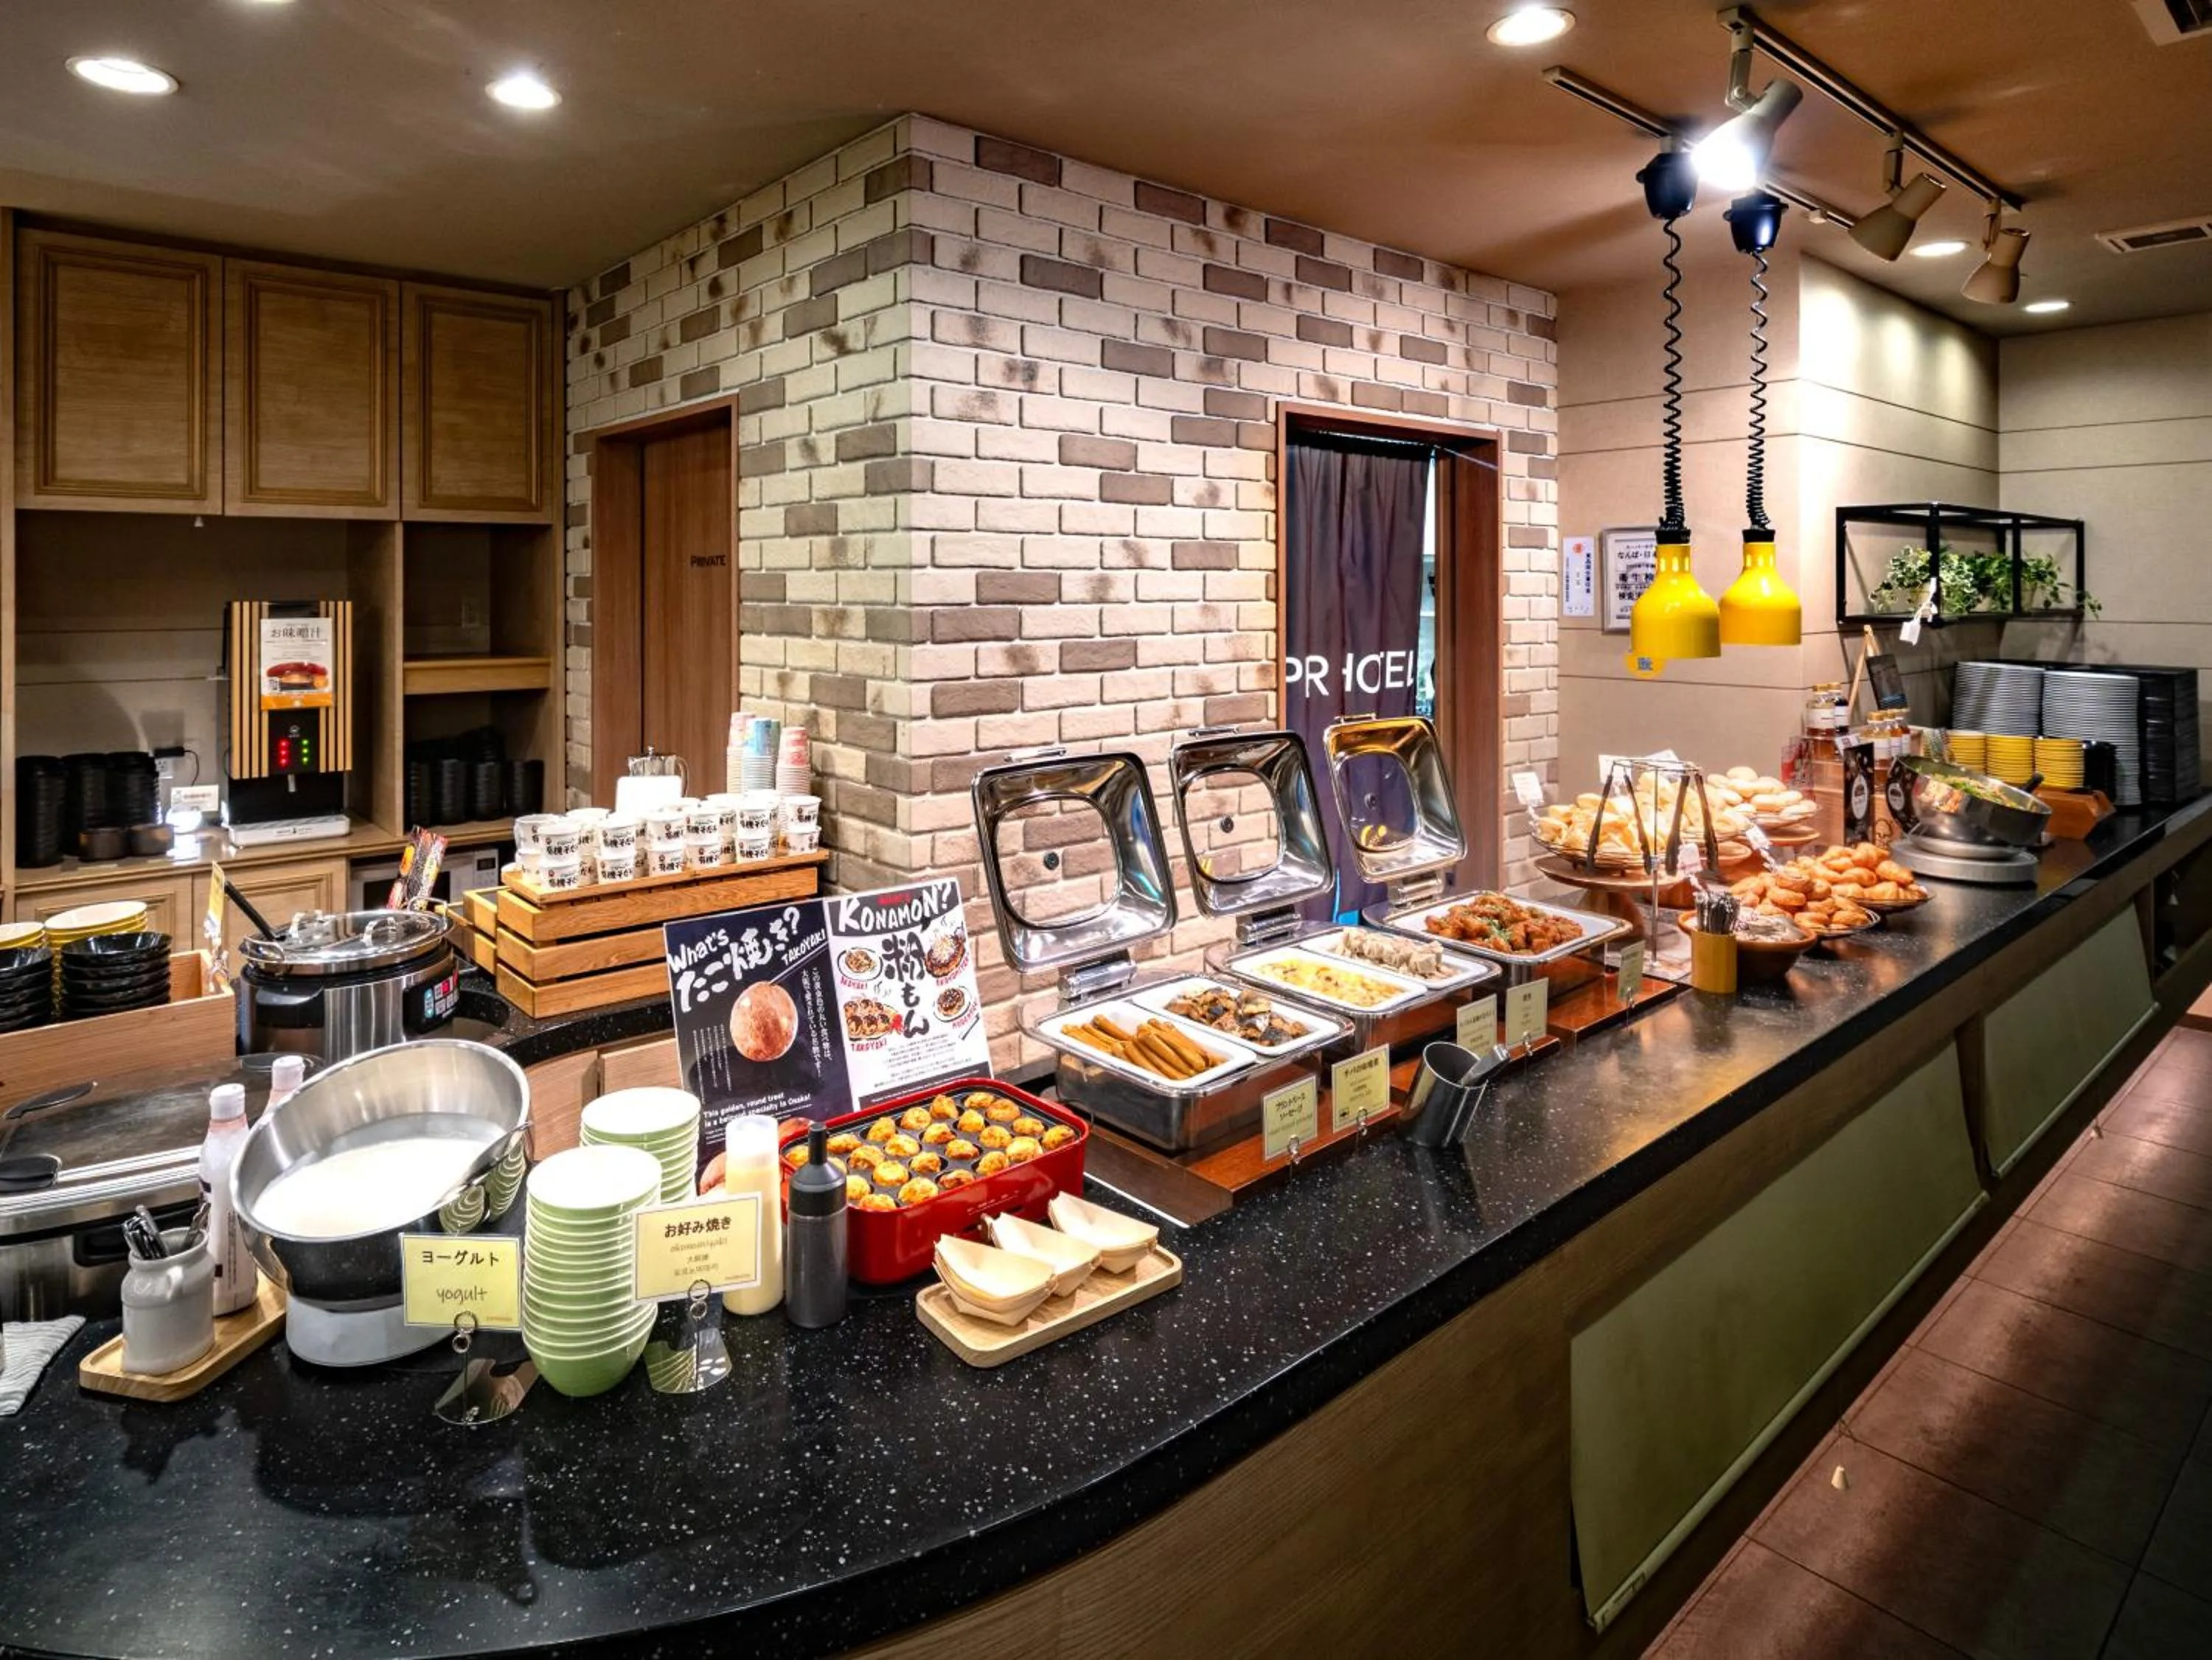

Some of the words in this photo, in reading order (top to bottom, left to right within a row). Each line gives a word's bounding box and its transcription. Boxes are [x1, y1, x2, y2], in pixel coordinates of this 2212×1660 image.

[1342, 650, 1414, 694] HOEL
[838, 882, 951, 932] KONAMON?
[666, 928, 729, 973] What's
[781, 929, 826, 966] TAKOYAKI
[881, 931, 930, 1039] 粉もん
[703, 1110, 719, 1119] This
[747, 1096, 766, 1107] round
[768, 1092, 785, 1102] treat
[705, 1120, 712, 1128] is
[664, 1216, 731, 1238] お好み焼き
[422, 1250, 499, 1266] ヨーグルト
[437, 1285, 488, 1305] yogult
